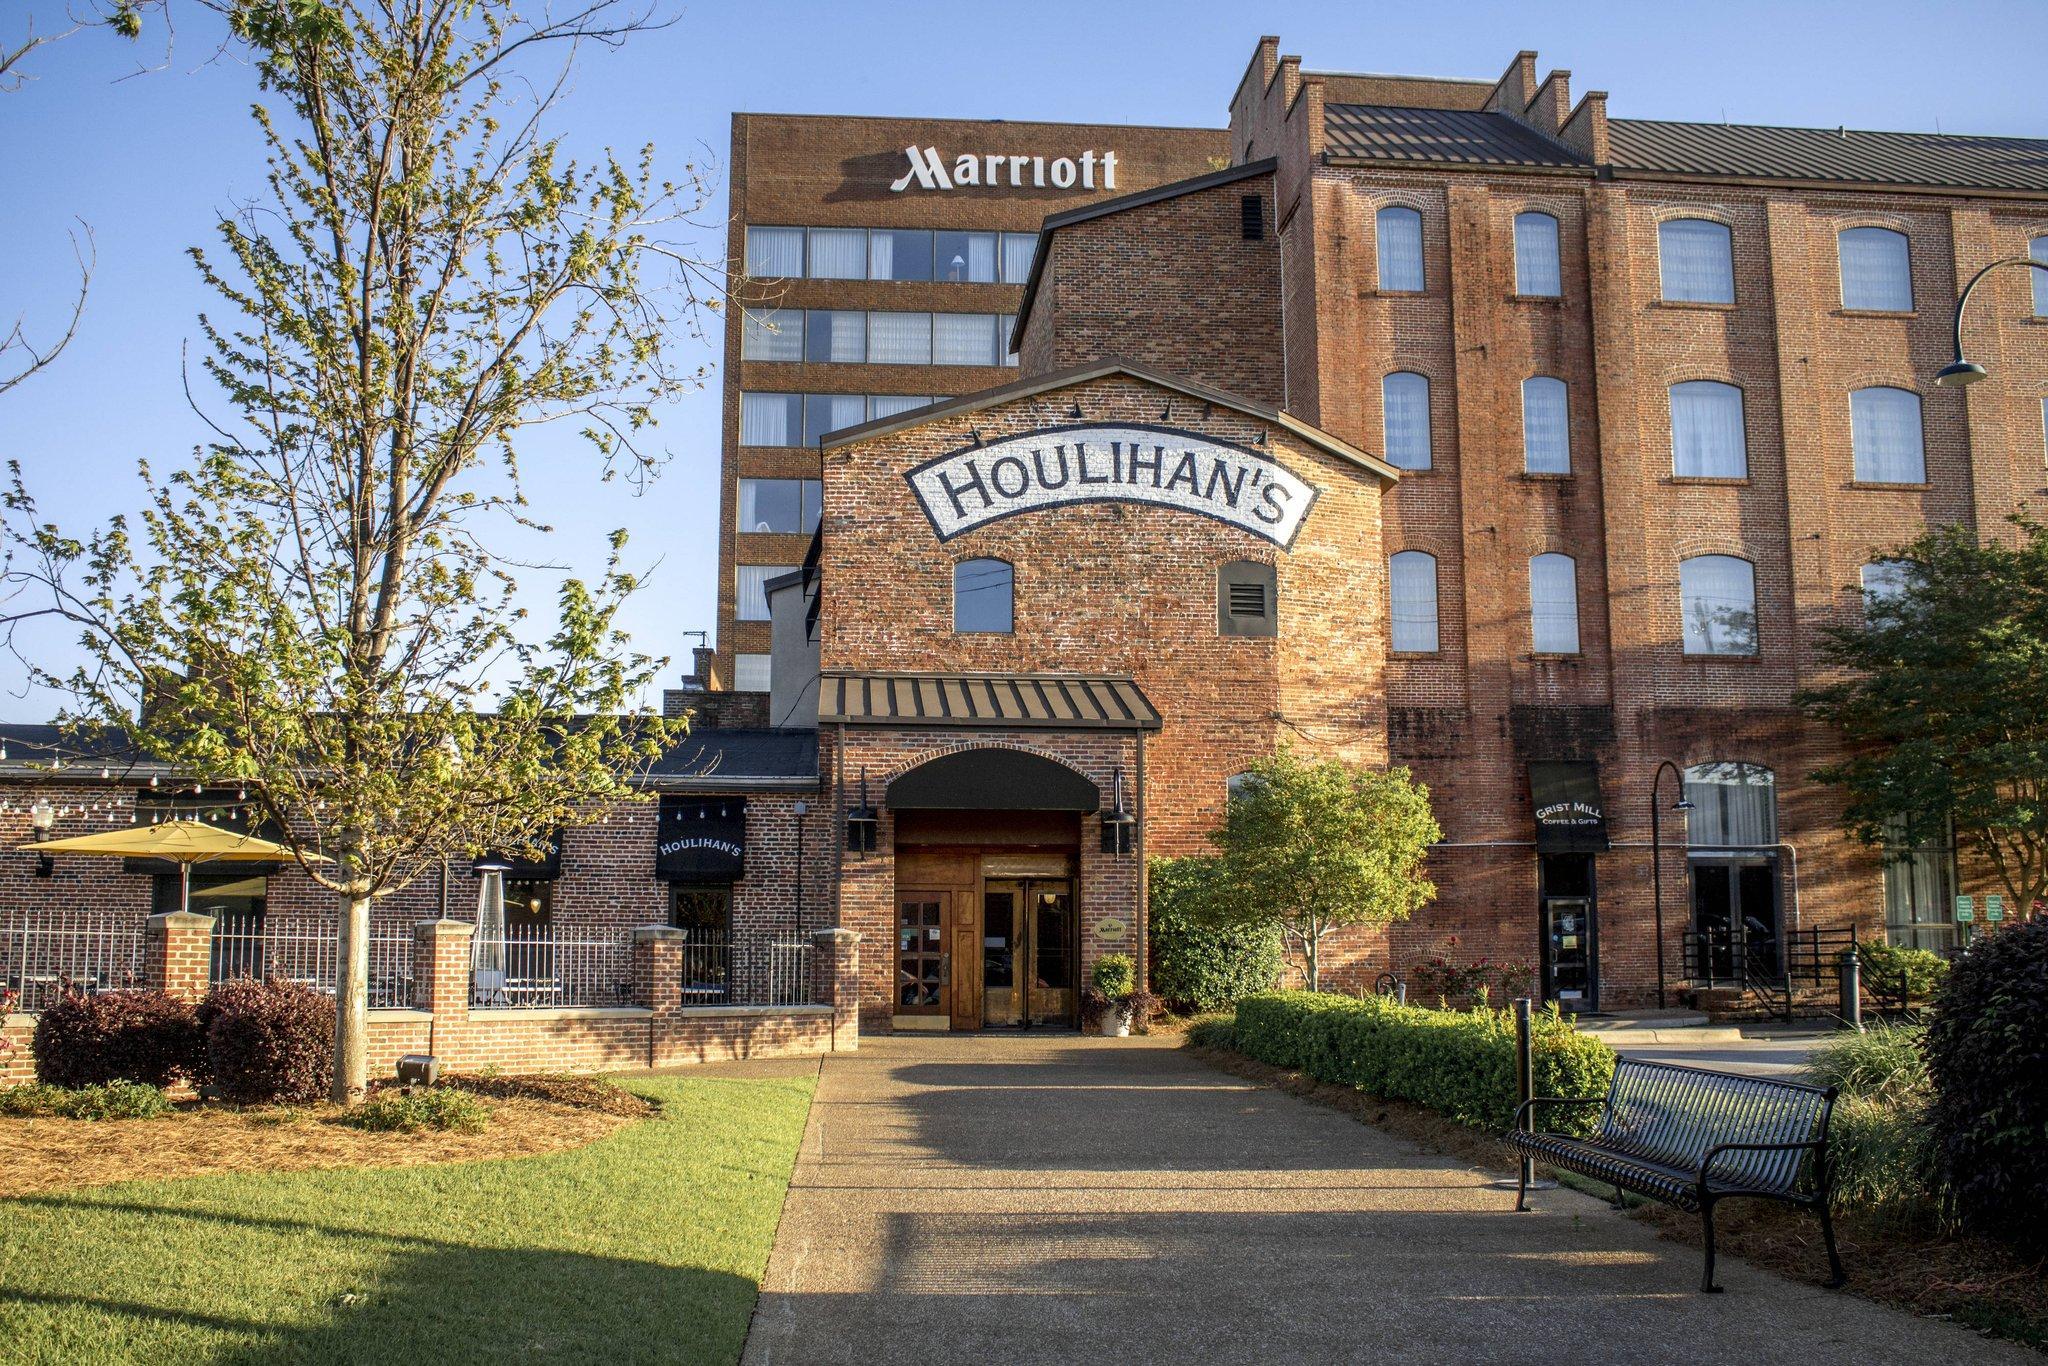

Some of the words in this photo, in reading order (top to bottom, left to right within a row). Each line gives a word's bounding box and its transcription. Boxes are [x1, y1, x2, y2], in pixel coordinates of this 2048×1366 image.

[889, 145, 1119, 192] Marriott
[936, 441, 1293, 524] HOULIHAN'S
[1536, 803, 1570, 819] GRIST
[1573, 802, 1602, 818] MILL
[660, 838, 742, 857] HOULIHAN'S
